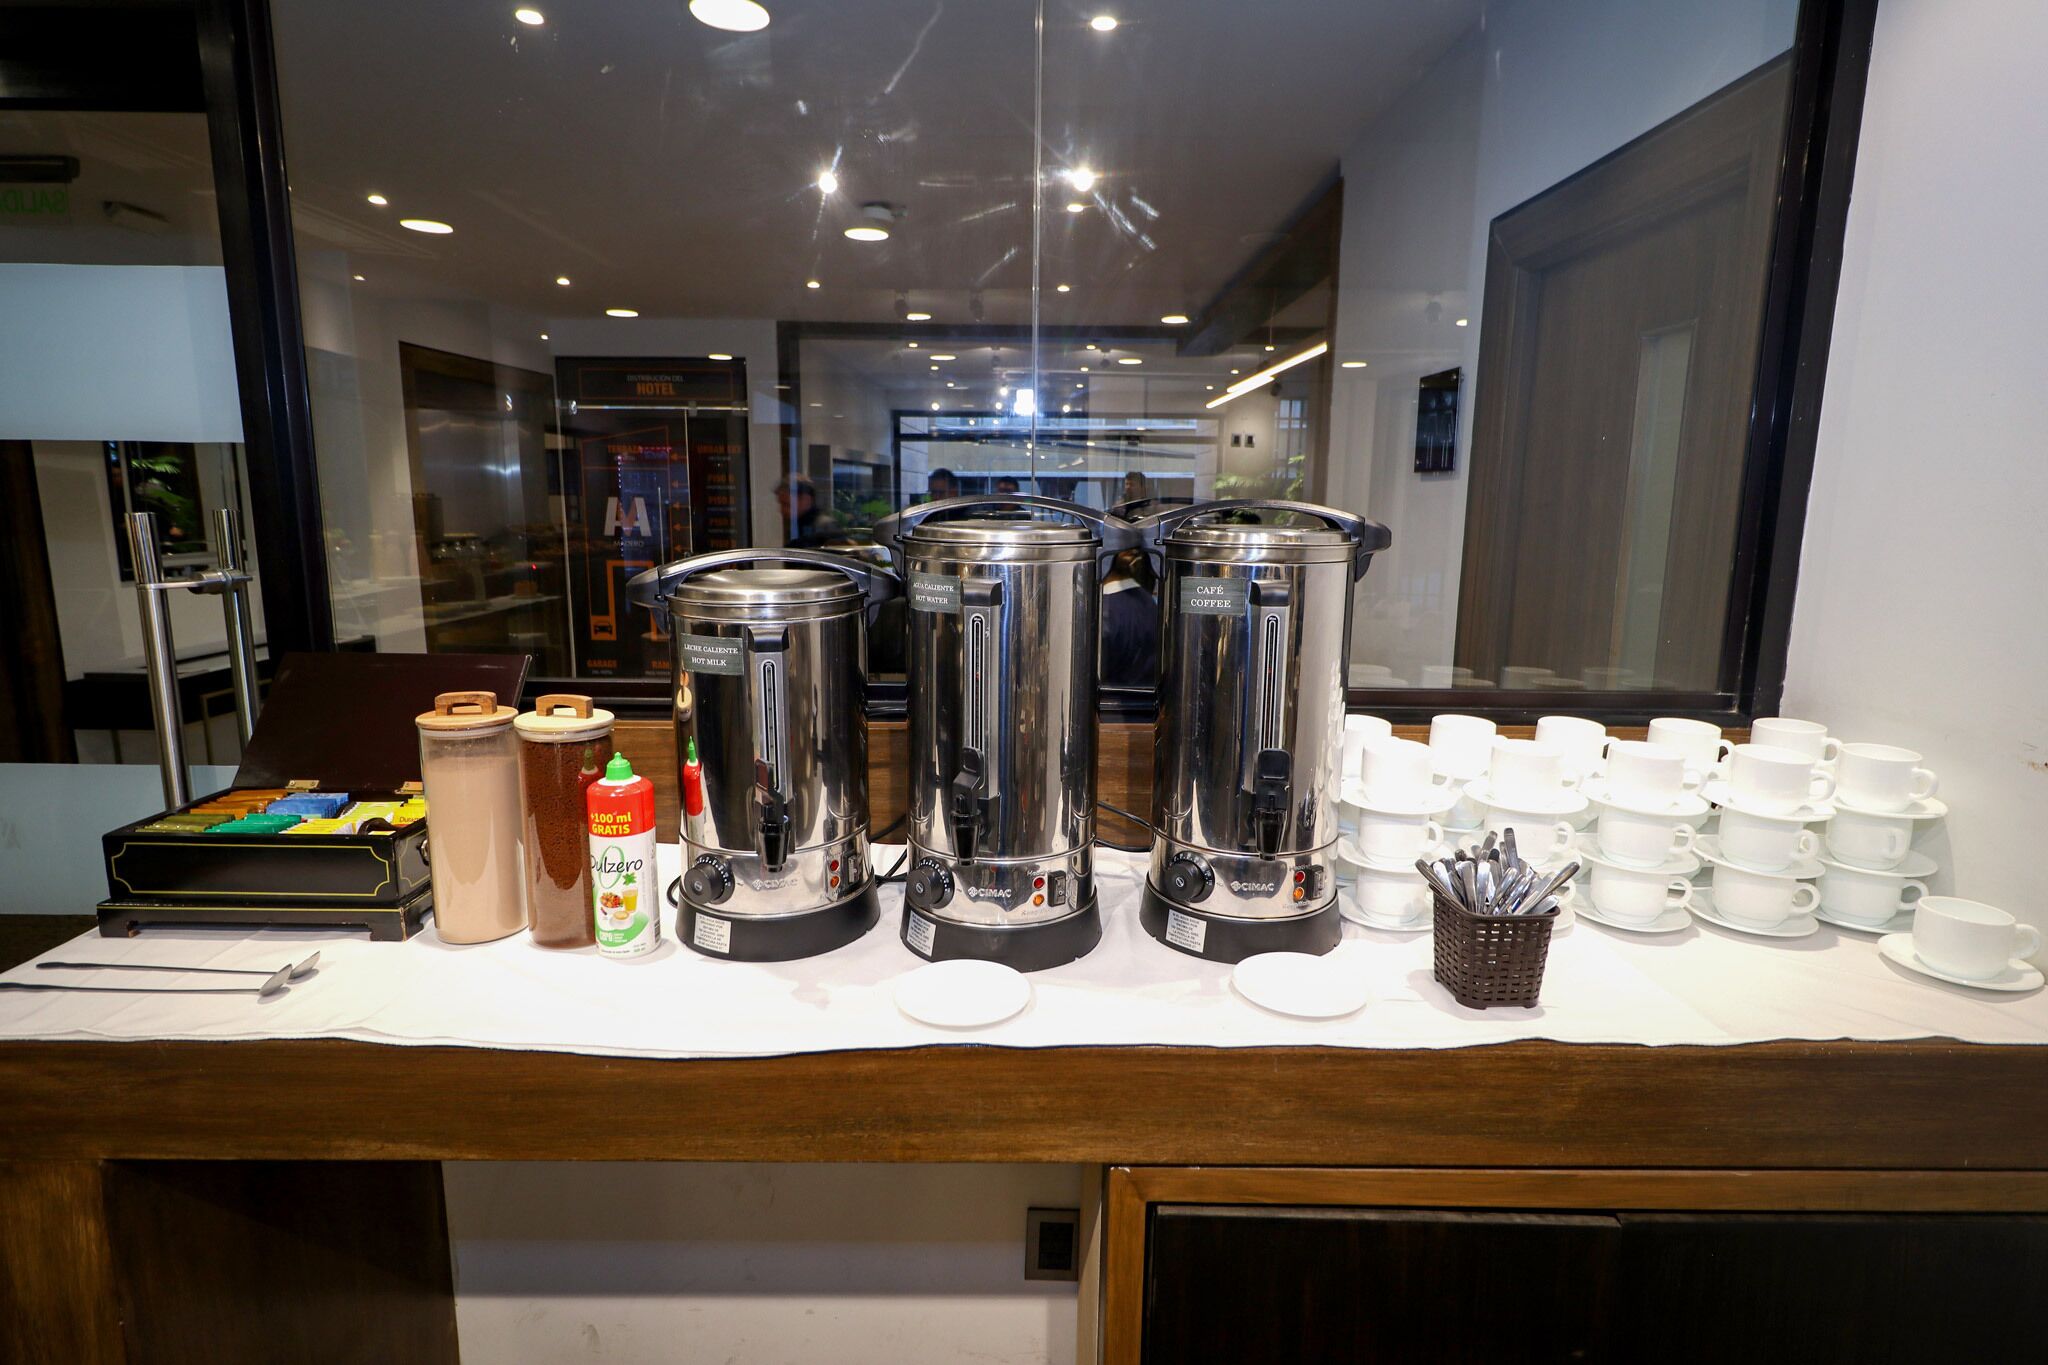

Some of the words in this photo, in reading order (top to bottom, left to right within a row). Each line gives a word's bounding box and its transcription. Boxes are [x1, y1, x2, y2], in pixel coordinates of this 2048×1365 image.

[636, 382, 676, 395] HOTEL
[925, 583, 954, 592] CALIENTE
[1196, 584, 1224, 595] CAFÉ
[926, 596, 948, 604] WATER
[1190, 599, 1231, 608] COFFEE
[684, 643, 702, 652] LECHE
[703, 646, 739, 654] CALIENTE
[691, 656, 705, 665] HOT
[706, 658, 727, 666] MILK
[616, 811, 633, 823] ml
[592, 824, 631, 835] GRATIS
[1240, 882, 1275, 892] CIMAC
[978, 888, 1012, 898] CIMAC
